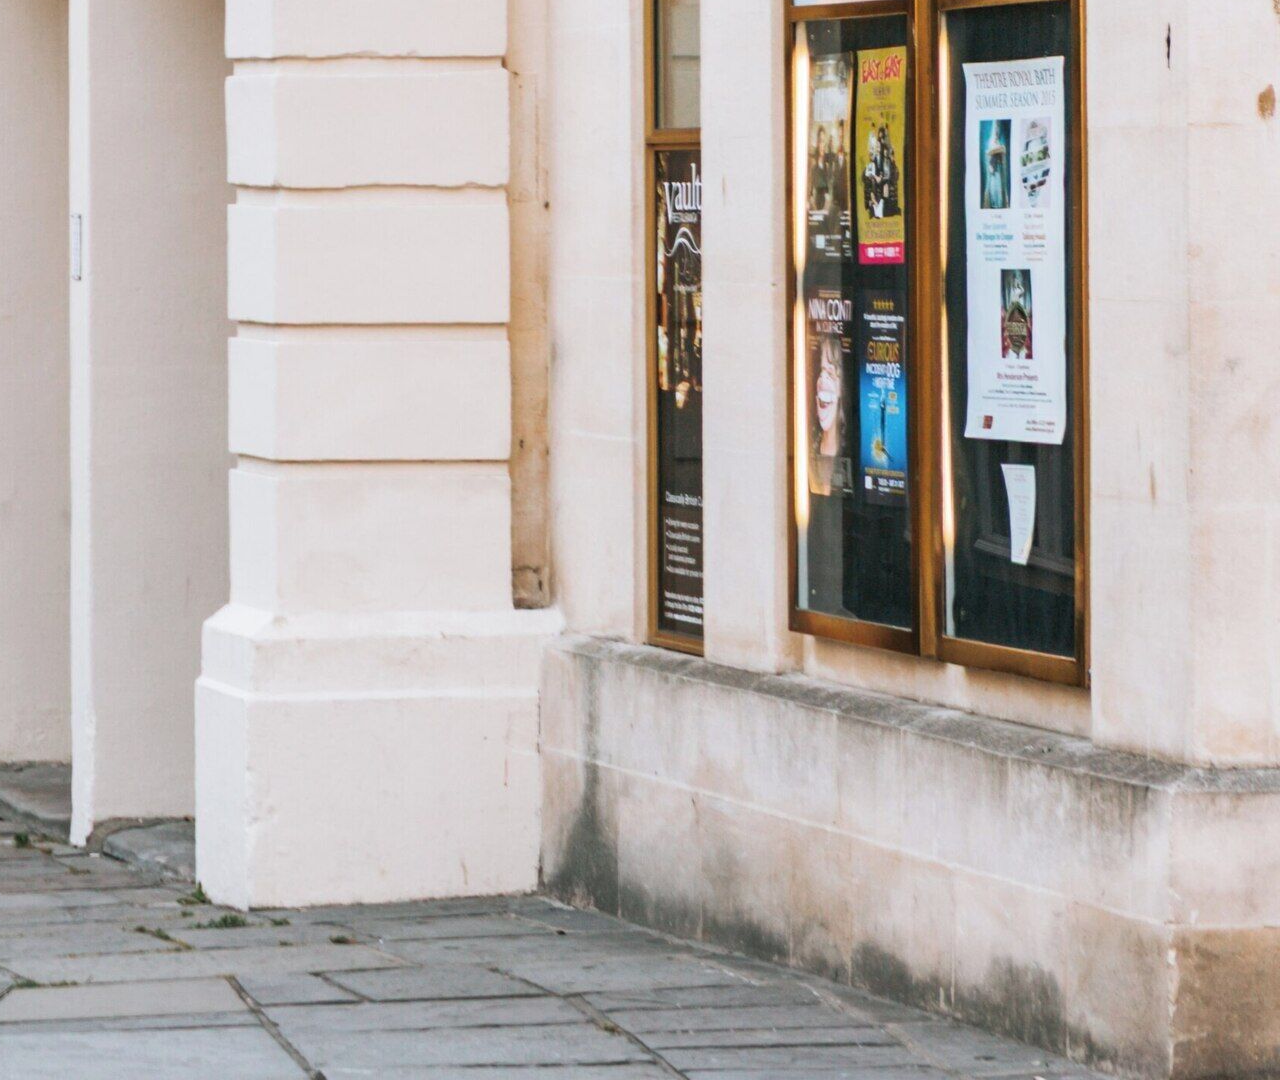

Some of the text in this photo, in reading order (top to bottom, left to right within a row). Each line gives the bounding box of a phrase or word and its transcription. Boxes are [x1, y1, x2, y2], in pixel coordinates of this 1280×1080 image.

[973, 67, 1056, 90] THEATRE ROYAL BATH
[975, 93, 1008, 110] SUMMER
[1009, 91, 1039, 108] SEASON
[808, 299, 827, 320] NINA
[867, 341, 900, 362] CURIOUS
